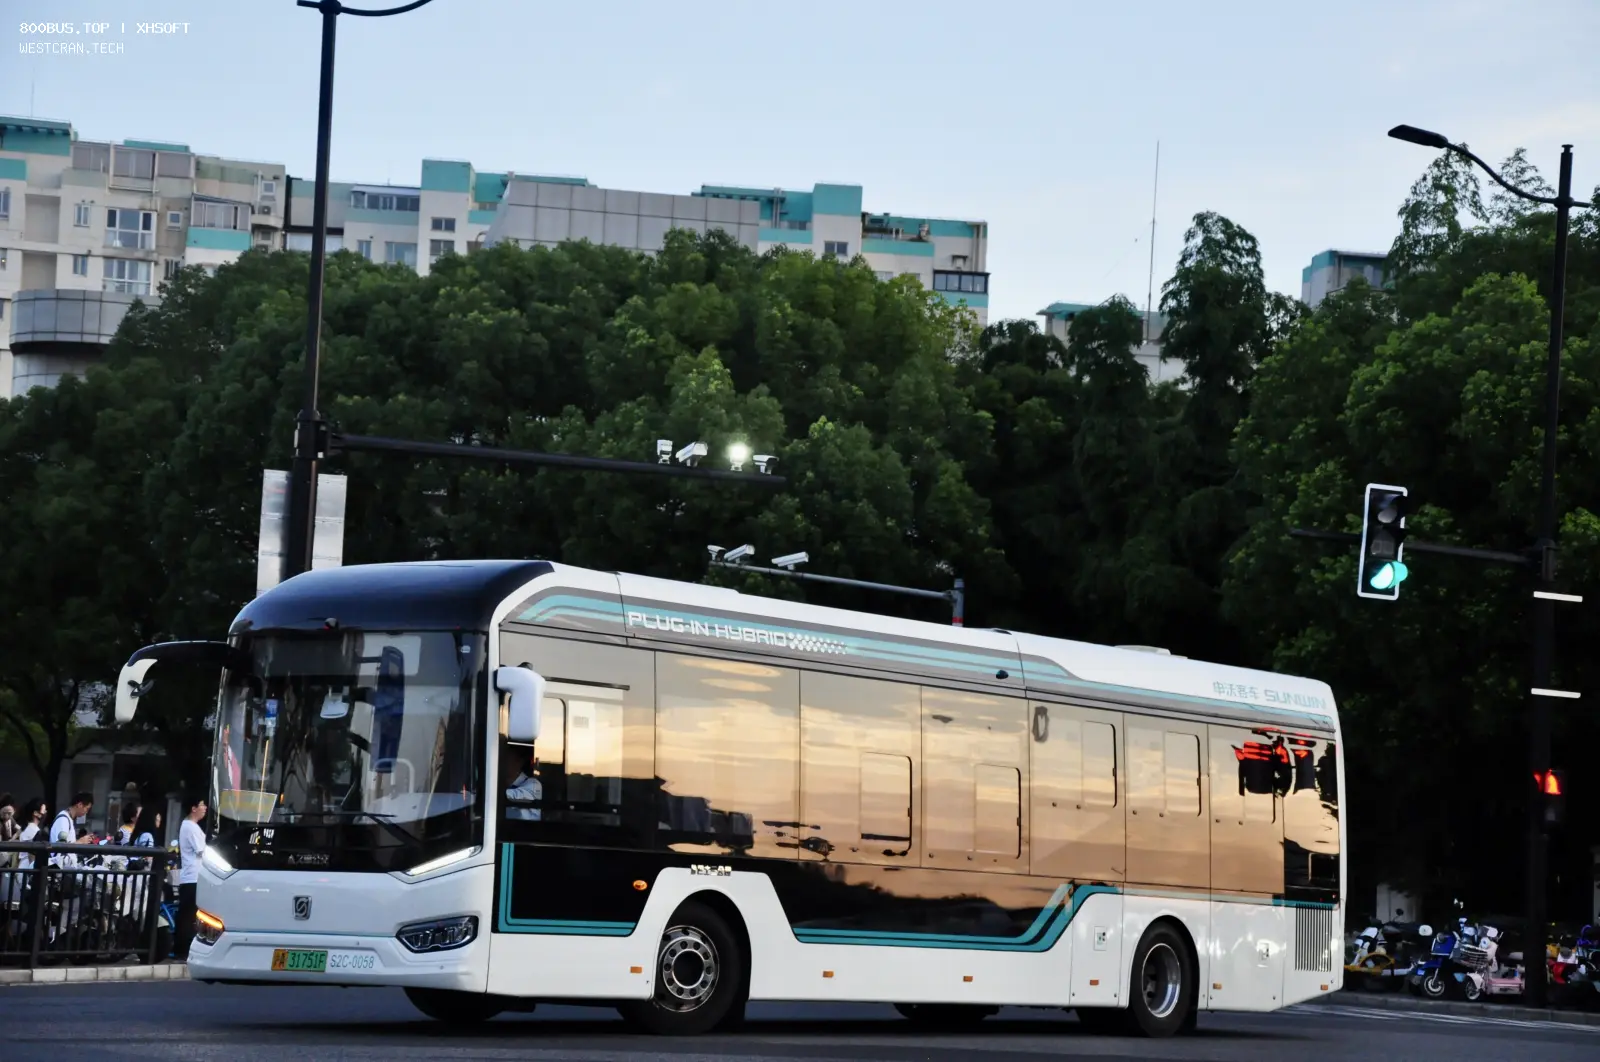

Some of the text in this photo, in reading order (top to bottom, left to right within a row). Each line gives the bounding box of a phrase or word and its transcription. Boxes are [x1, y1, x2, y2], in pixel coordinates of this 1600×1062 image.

[627, 611, 788, 647] PLUG-IN HYBRID
[1212, 681, 1260, 700] 申沃客车
[1263, 689, 1328, 710] SUNWIN
[330, 954, 375, 969] S2C-0058
